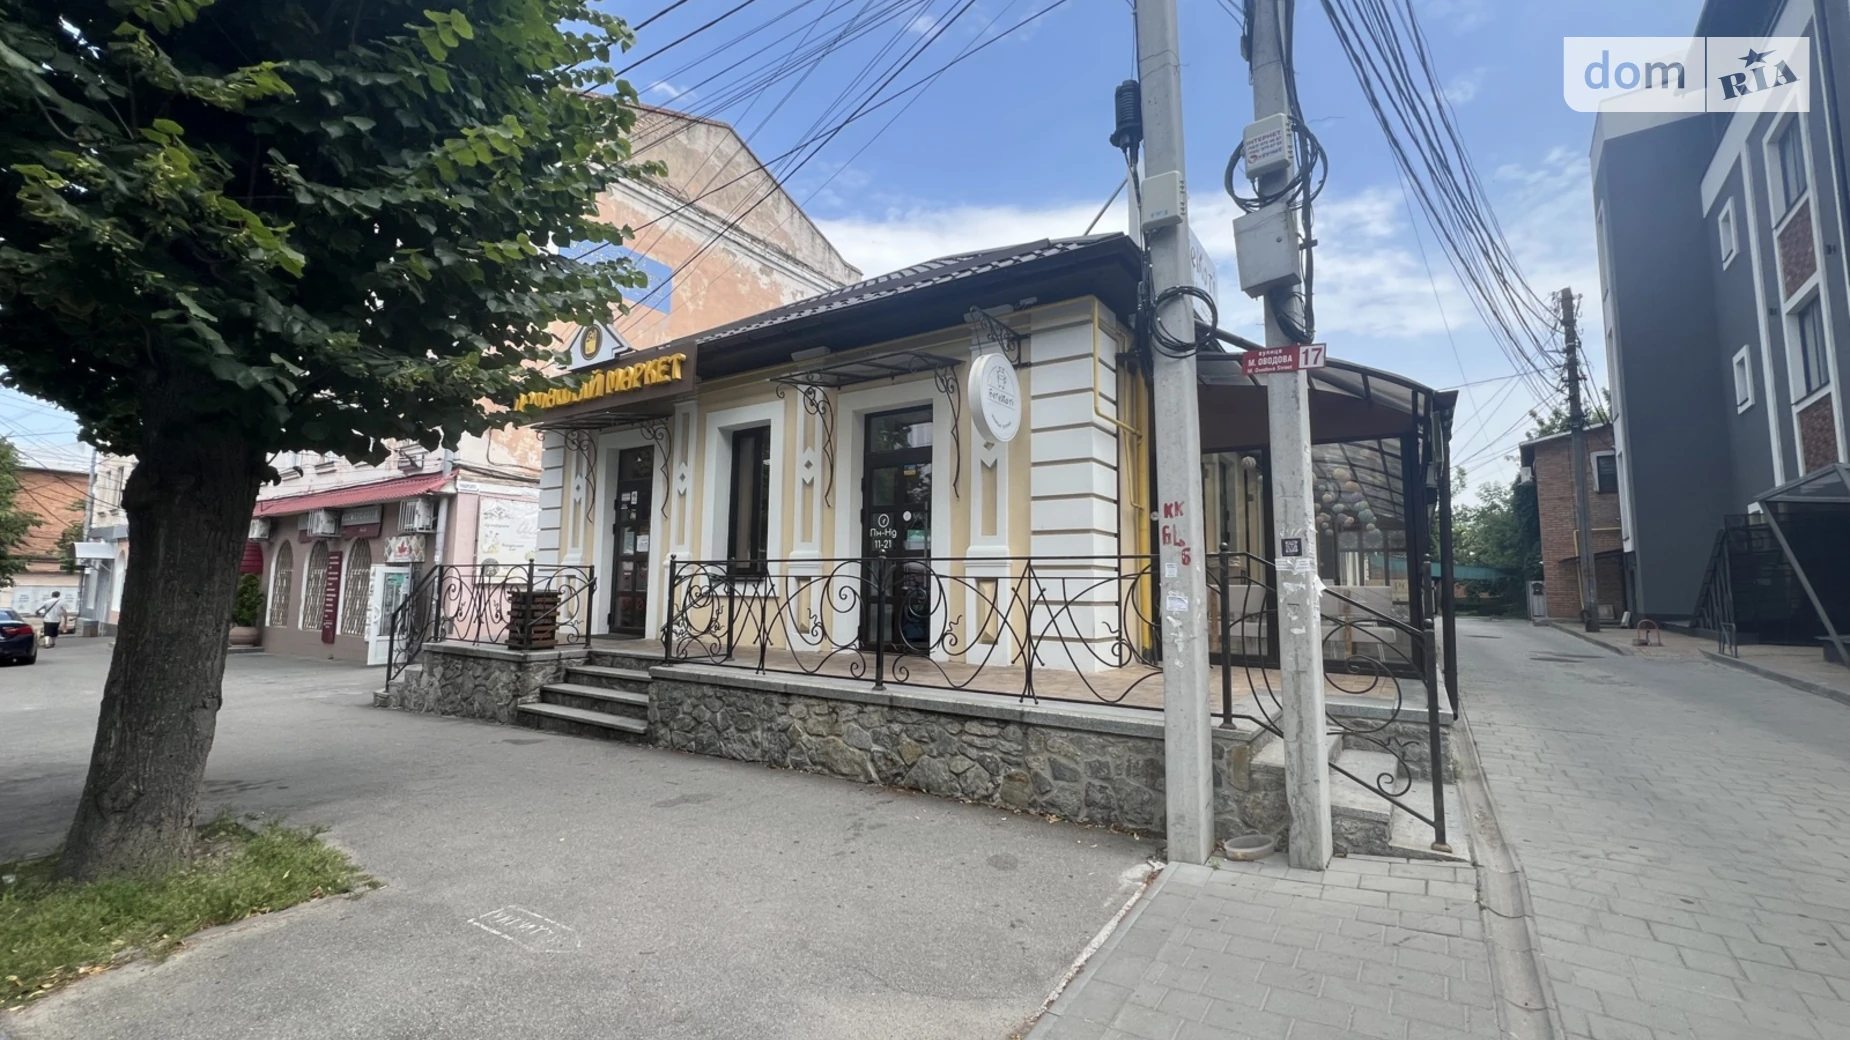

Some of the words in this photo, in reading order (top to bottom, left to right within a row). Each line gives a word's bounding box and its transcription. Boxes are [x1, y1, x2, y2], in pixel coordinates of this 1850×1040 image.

[1257, 354, 1293, 366] ОВОДОВА
[1301, 347, 1323, 366] 17
[605, 352, 687, 394] МАРКЕТ
[874, 539, 892, 549] 11-21
